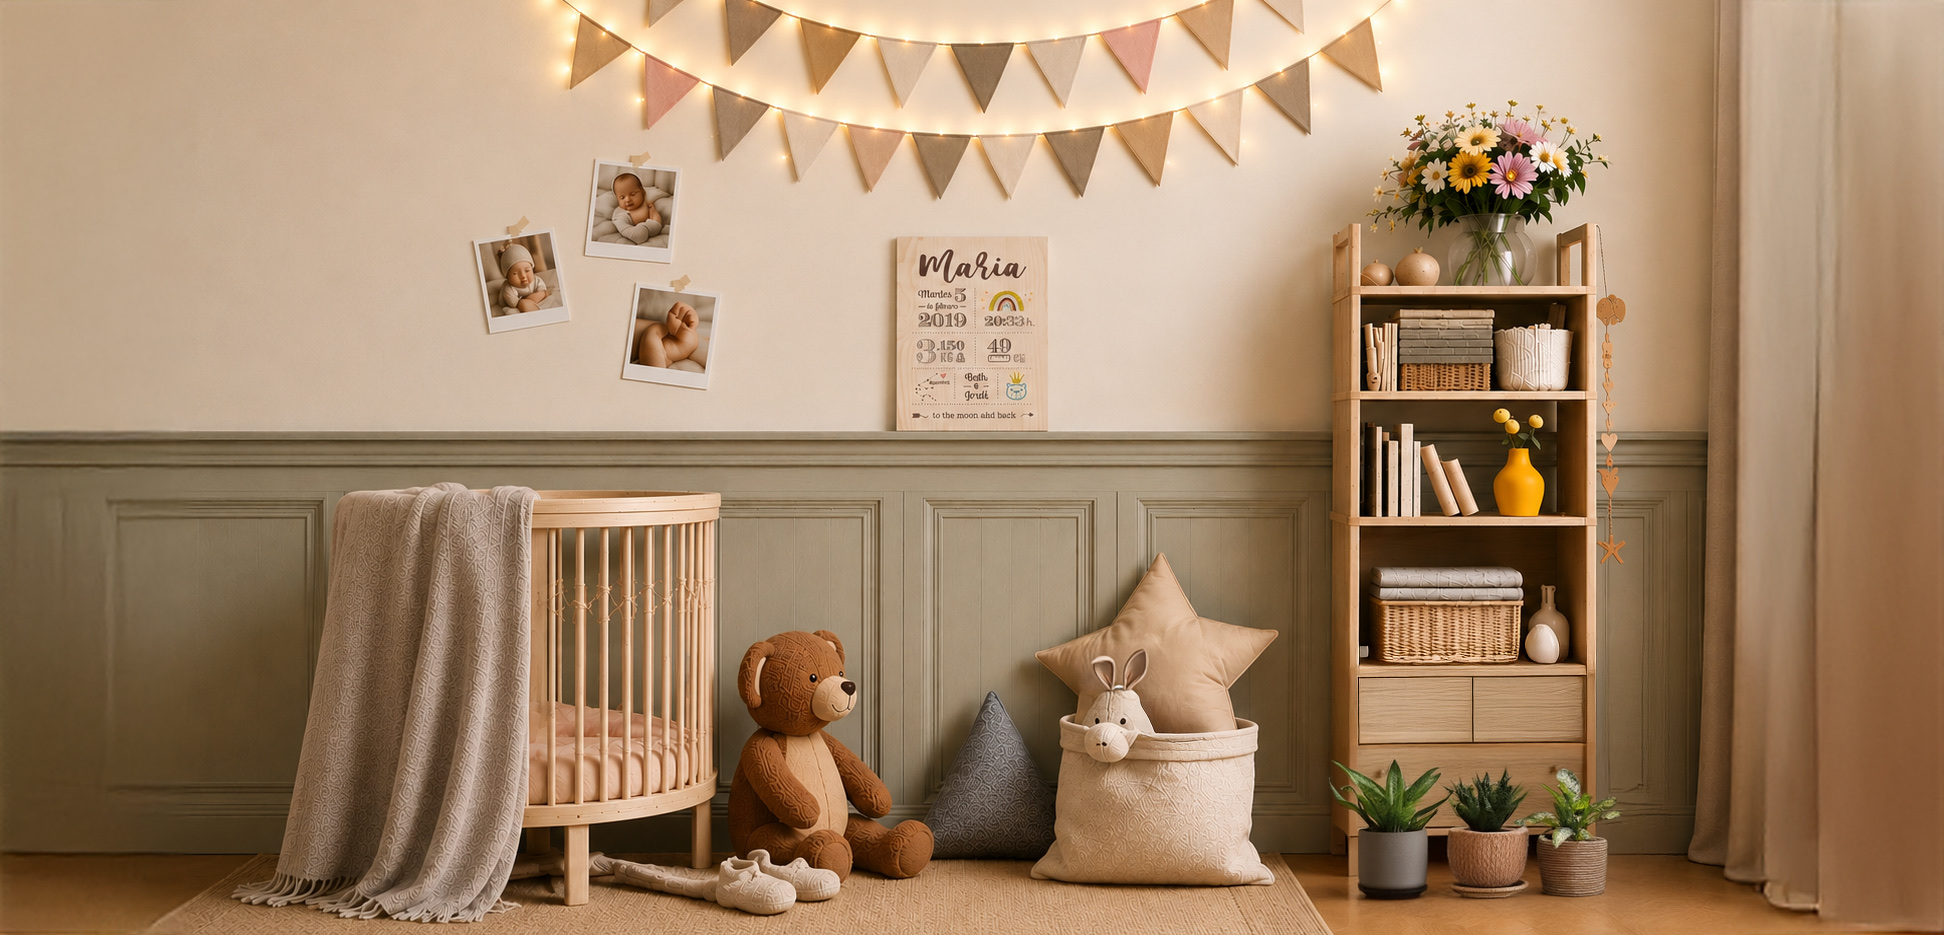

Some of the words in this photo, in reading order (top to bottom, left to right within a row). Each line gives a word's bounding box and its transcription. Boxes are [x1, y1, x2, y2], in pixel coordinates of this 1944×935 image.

[918, 248, 1027, 284] Maria
[954, 287, 967, 303] 5
[917, 312, 967, 328] 2019
